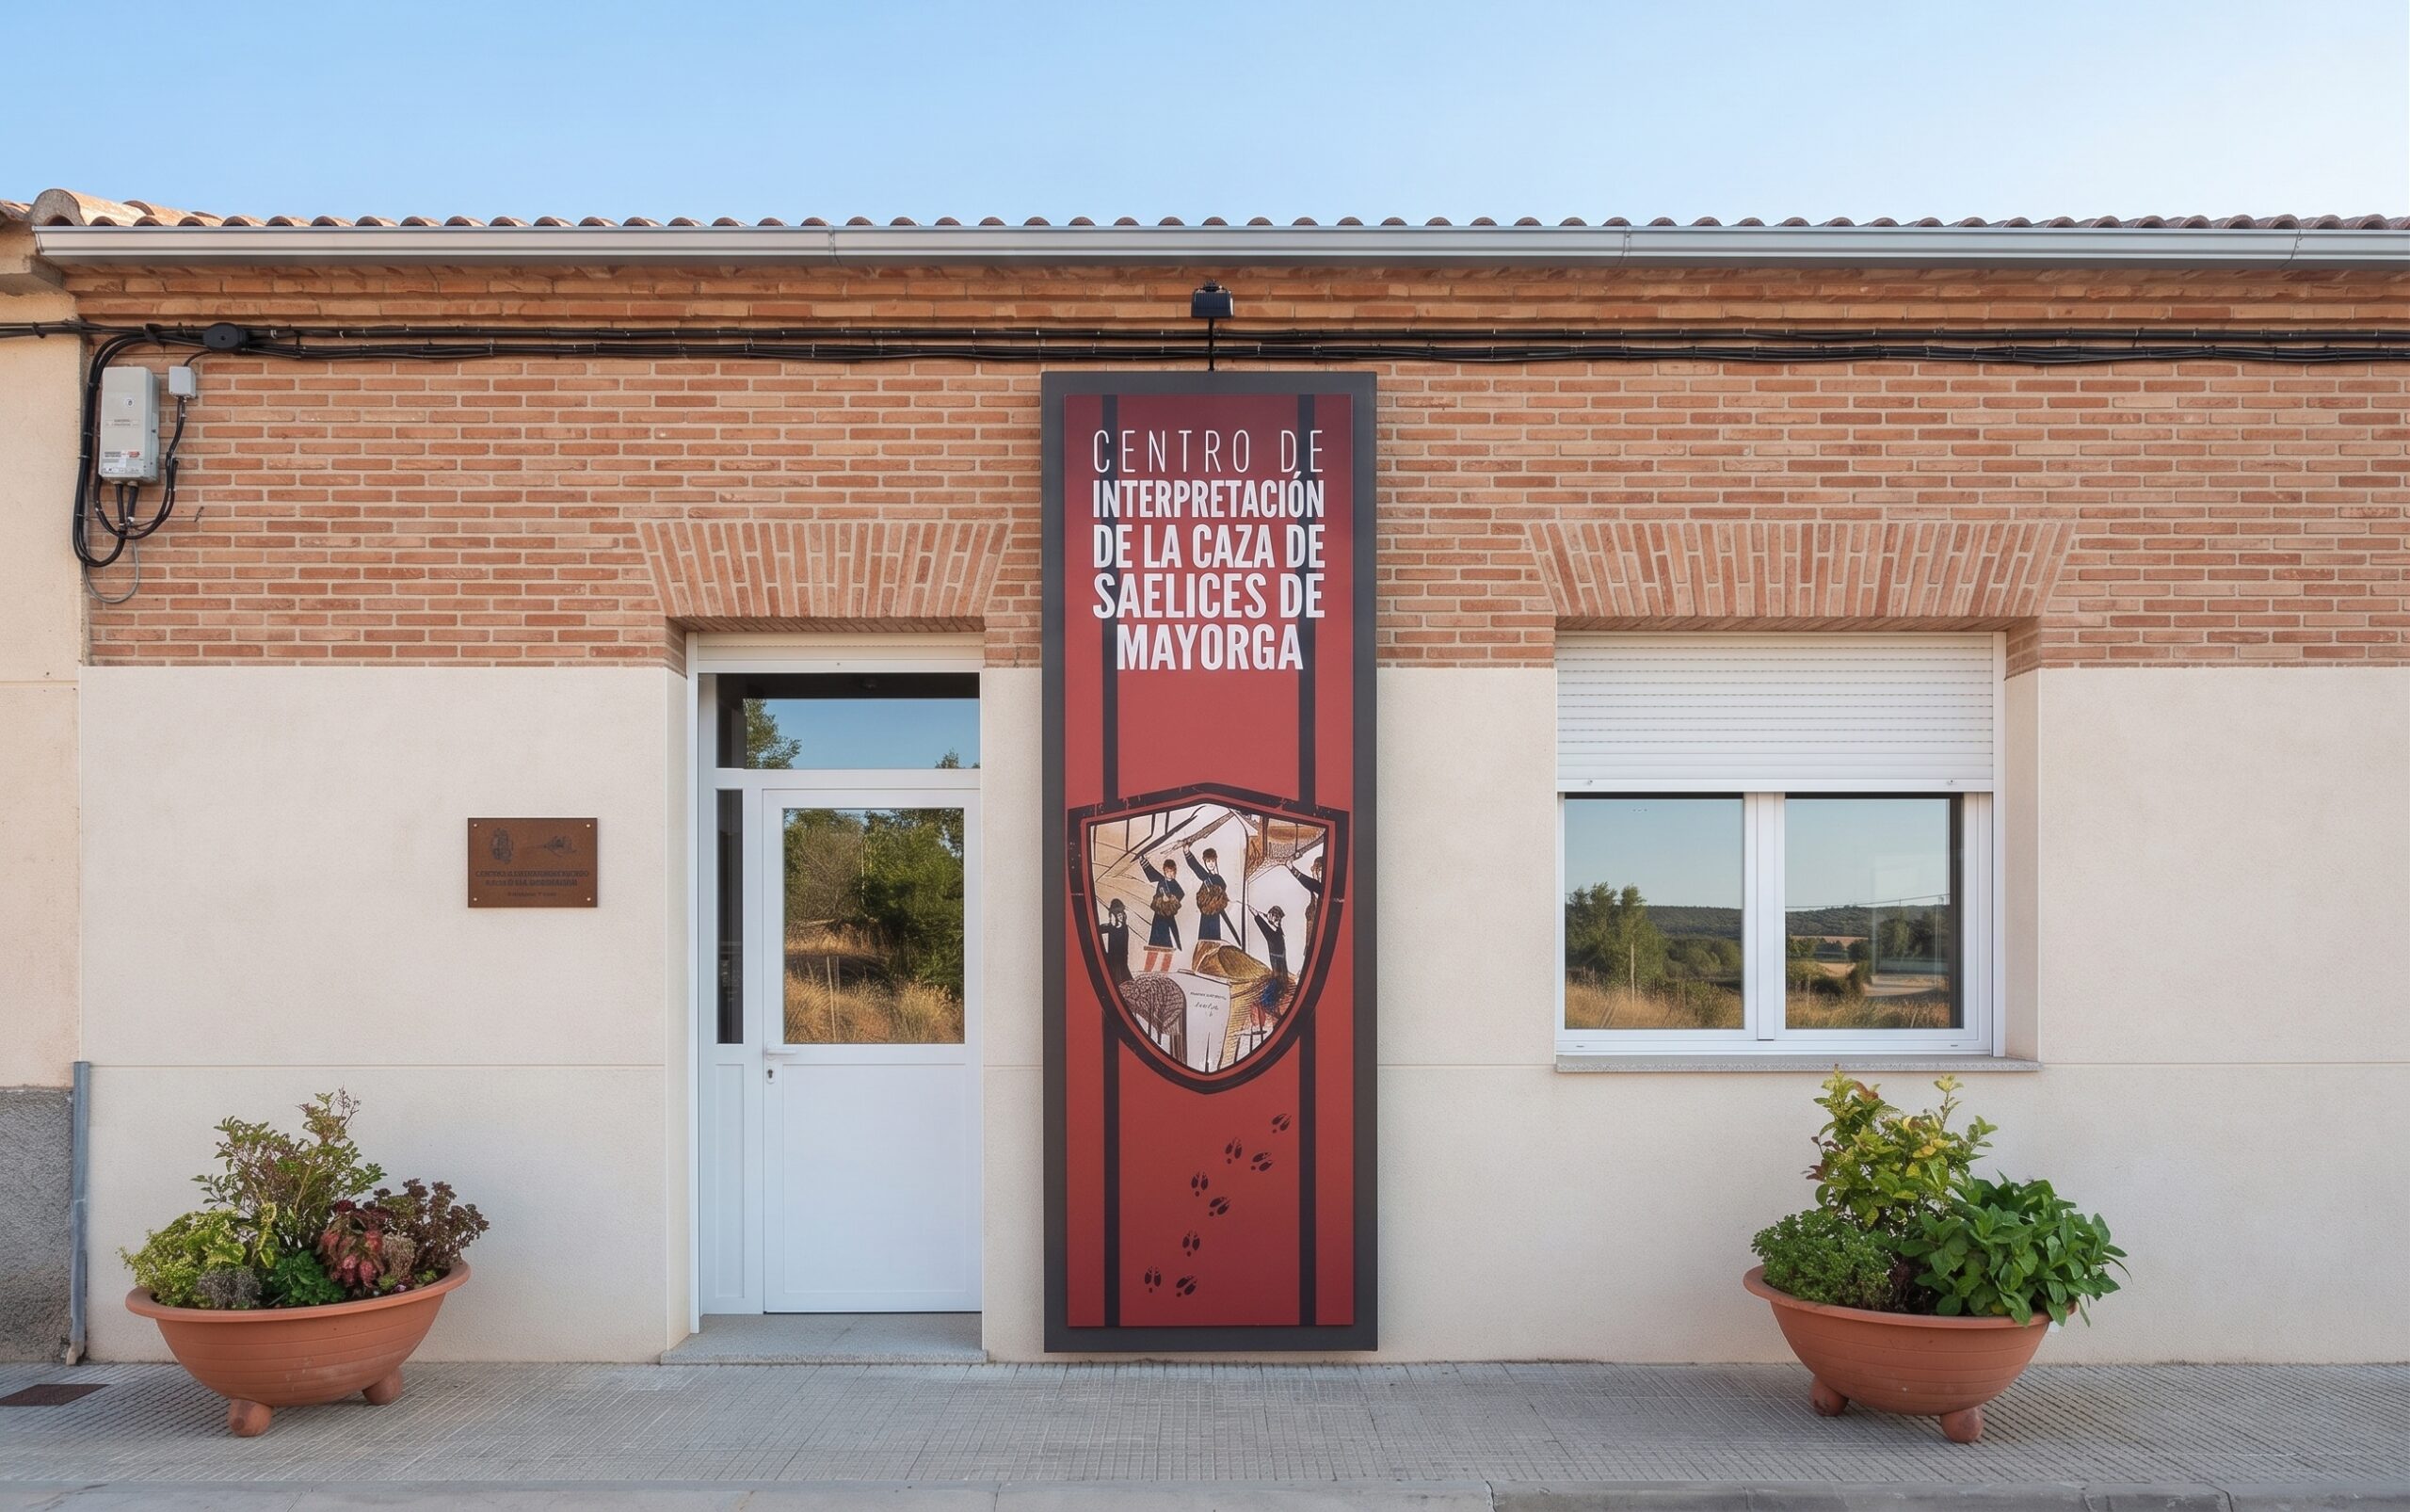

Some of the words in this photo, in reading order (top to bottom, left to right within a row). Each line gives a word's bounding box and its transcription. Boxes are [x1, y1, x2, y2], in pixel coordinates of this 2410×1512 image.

[1093, 429, 1250, 473] CENTRO
[1281, 429, 1324, 473] DE
[1093, 471, 1325, 518] INTERPRETACIÓN
[1093, 524, 1133, 569] DE
[1144, 524, 1182, 569] LA
[1193, 524, 1276, 569] CAZA
[1286, 524, 1326, 569] DE
[1092, 572, 1267, 619] SAELICES
[1280, 573, 1326, 618] DE
[1117, 624, 1304, 670] MAYORGA
